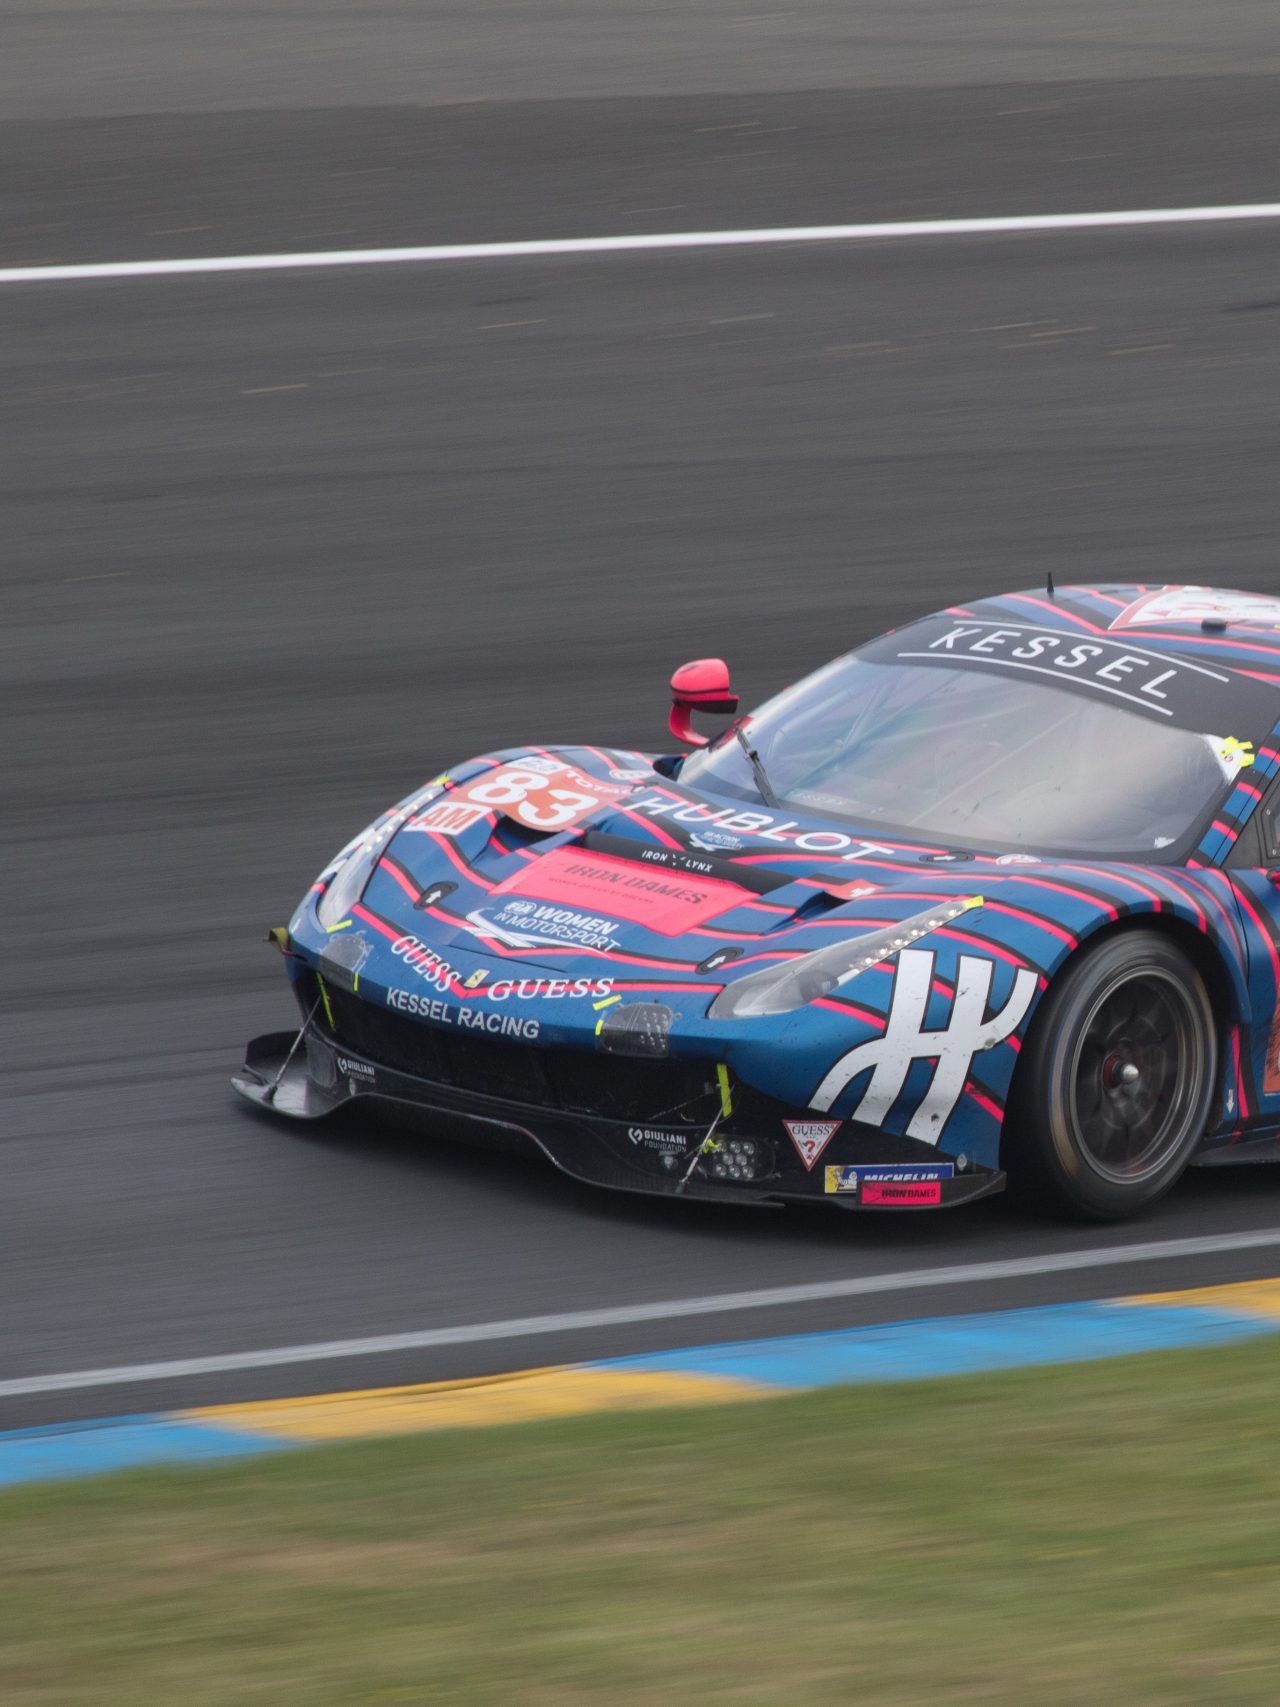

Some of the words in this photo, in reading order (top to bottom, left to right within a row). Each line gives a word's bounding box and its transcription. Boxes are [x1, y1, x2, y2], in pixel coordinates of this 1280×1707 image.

[929, 627, 1178, 700] KESSEL
[417, 806, 478, 831] AM
[467, 771, 598, 826] 83
[623, 797, 895, 860] HUBLOT
[642, 850, 669, 863] IRON
[685, 856, 713, 874] LYNX
[564, 864, 624, 884] IRON
[622, 876, 708, 905] DAMES
[493, 910, 511, 922] IN
[505, 914, 622, 952] MOTORSPORT
[533, 906, 620, 935] WOMEN
[391, 935, 460, 993] GUESS
[487, 977, 615, 1002] GUESS
[386, 988, 453, 1024] KESSEL
[457, 1008, 540, 1040] RACING
[644, 1130, 687, 1145] GIULIANI
[644, 1140, 687, 1152] FOUNDATION
[792, 1125, 830, 1135] GUESS
